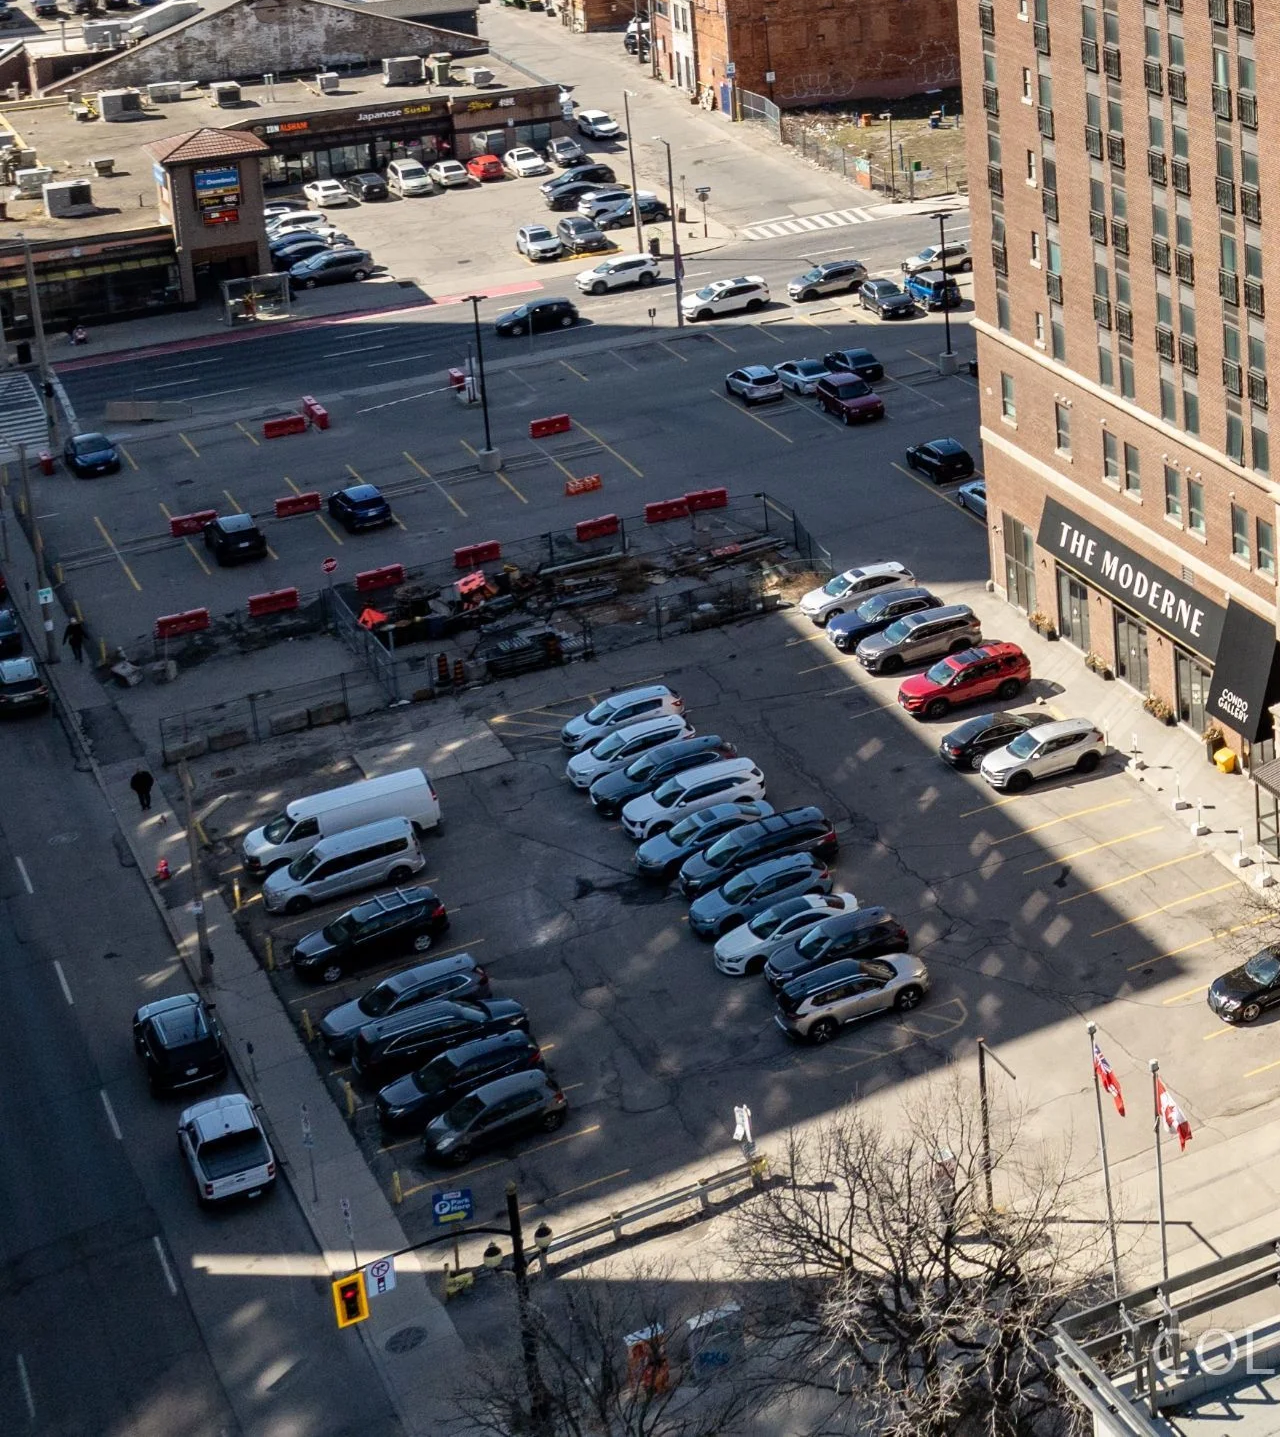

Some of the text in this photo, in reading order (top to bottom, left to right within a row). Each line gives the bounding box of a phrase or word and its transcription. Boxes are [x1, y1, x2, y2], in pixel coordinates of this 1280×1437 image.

[357, 105, 431, 122] Japanese Sushi
[1060, 521, 1205, 637] THE MODERNE
[1218, 697, 1249, 723] GALLERY
[1222, 688, 1248, 712] CONDO
